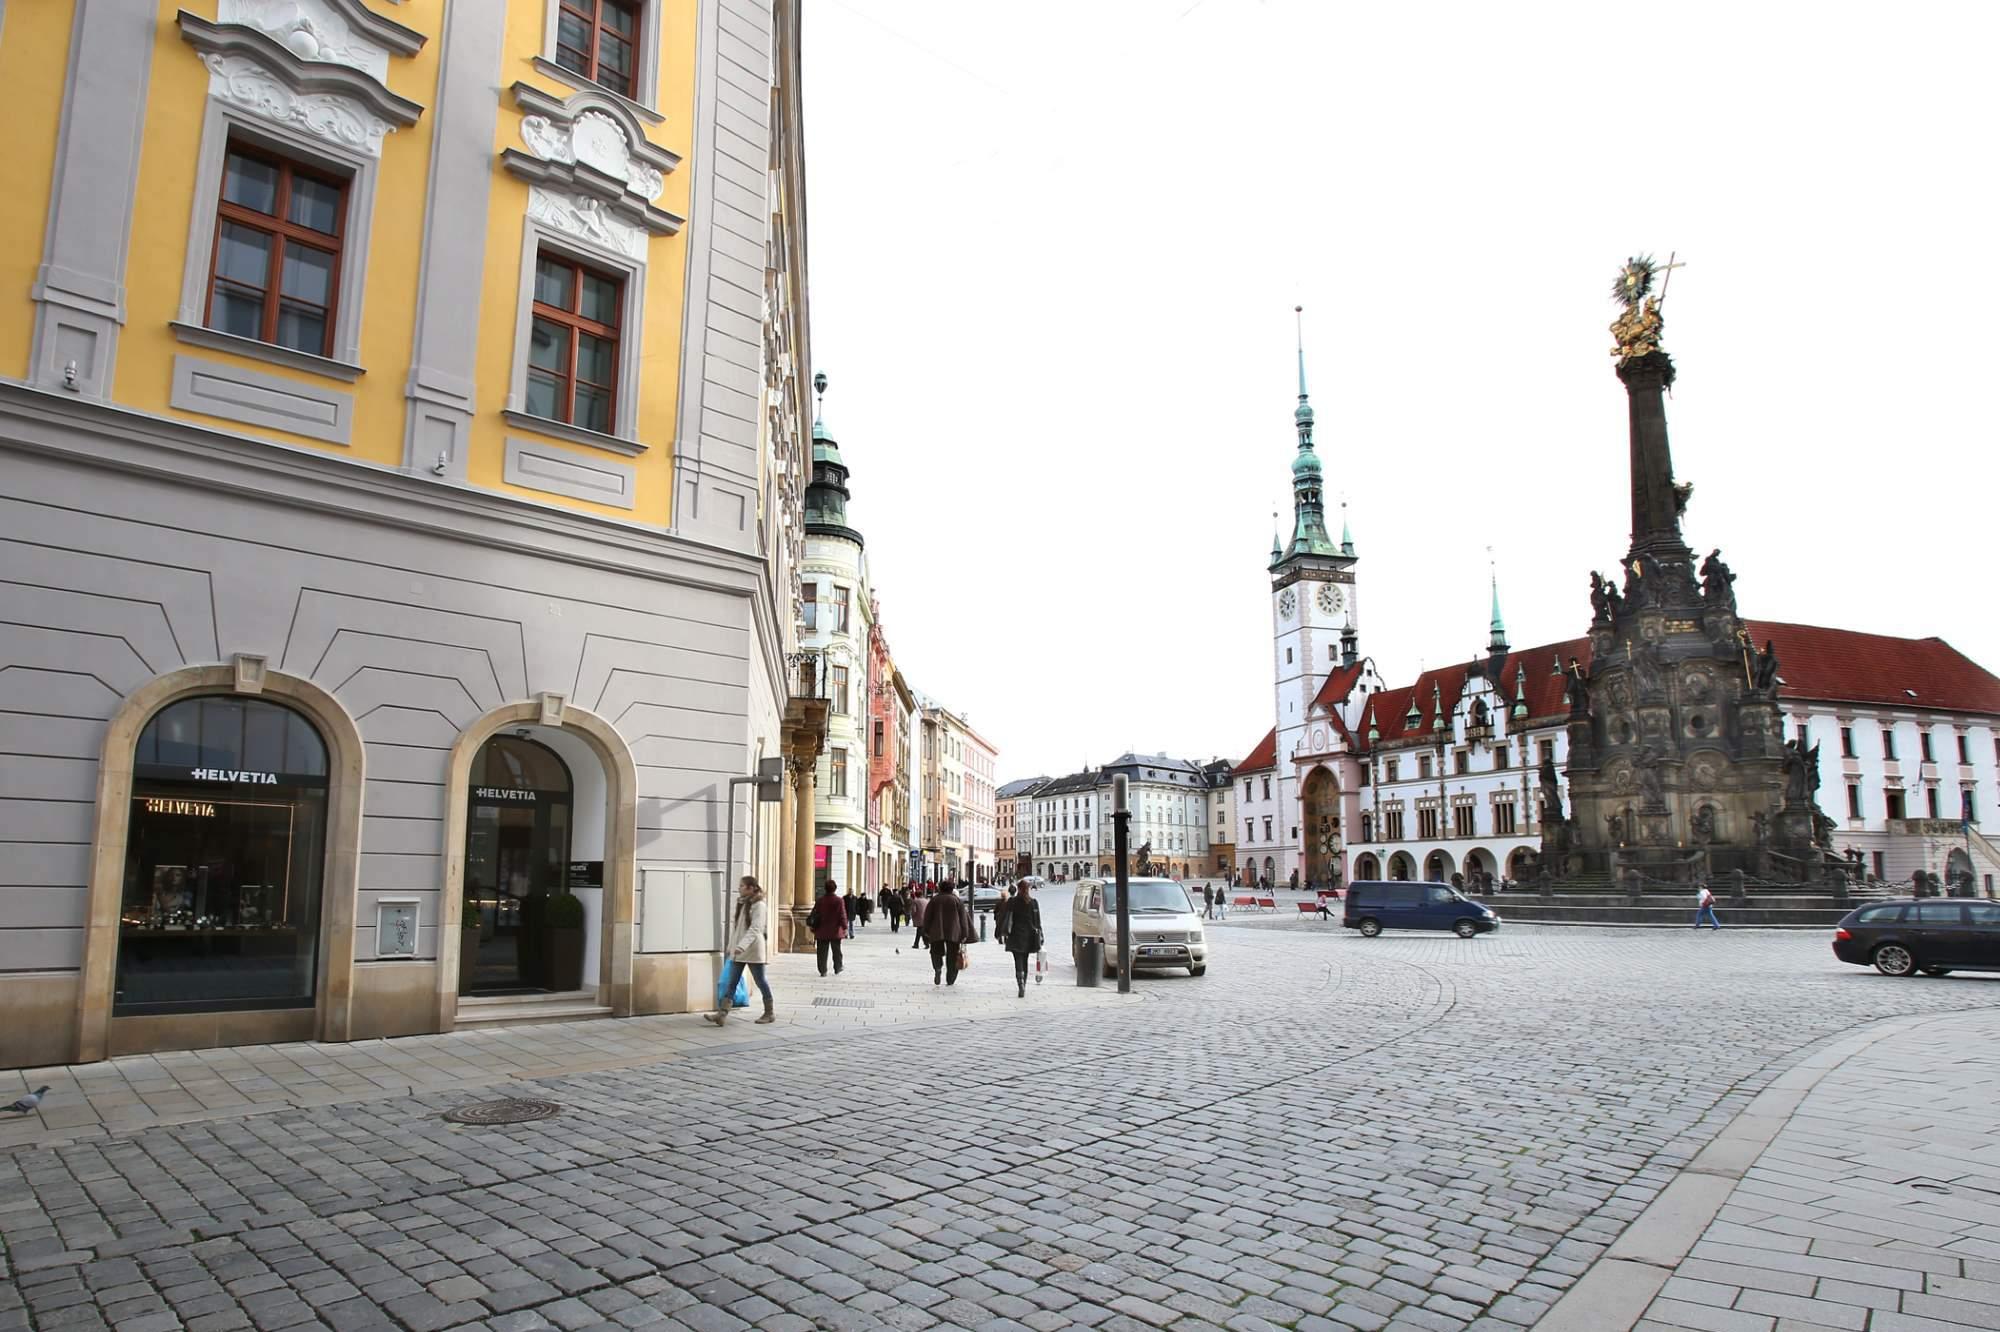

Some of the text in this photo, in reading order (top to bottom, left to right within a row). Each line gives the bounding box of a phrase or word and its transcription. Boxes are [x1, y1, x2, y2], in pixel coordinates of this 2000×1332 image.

[191, 768, 278, 785] HELVETIA
[476, 788, 536, 801] HELVETIA
[146, 798, 215, 817] HELVETIA
